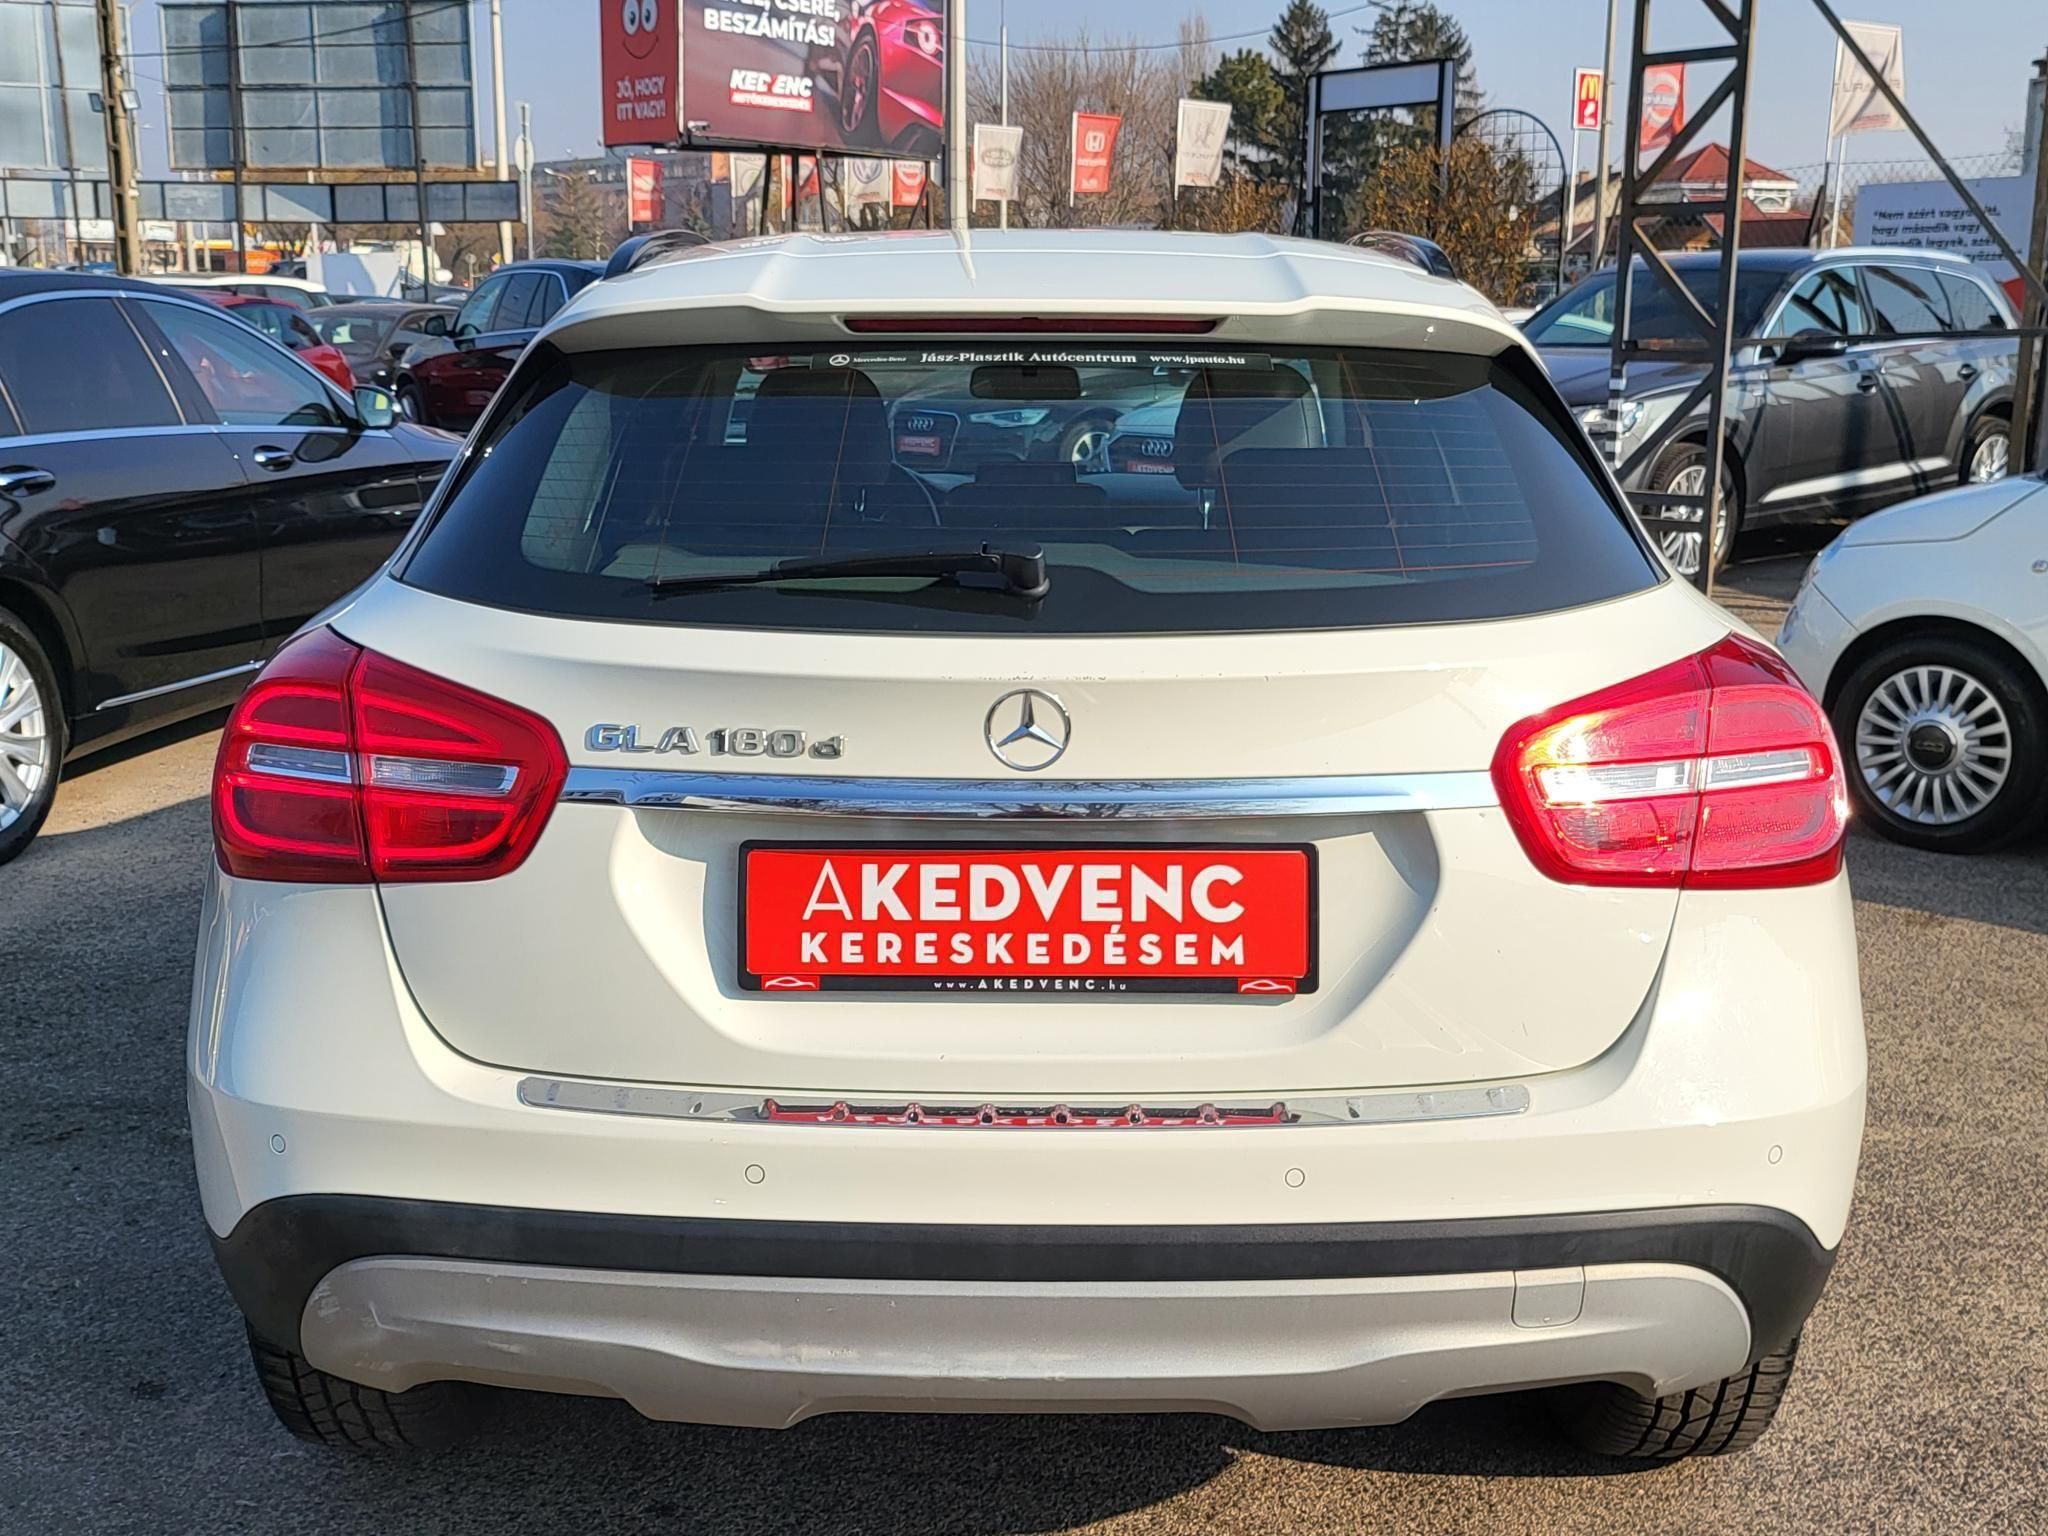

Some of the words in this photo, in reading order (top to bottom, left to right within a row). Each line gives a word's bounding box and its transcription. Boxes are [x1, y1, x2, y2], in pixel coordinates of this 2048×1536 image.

[703, 8, 835, 47] BESZÁMÍTÁS!
[635, 75, 665, 97] HOGY
[920, 352, 1024, 363] Jász-Plasztik
[1028, 352, 1137, 363] Autócentrum
[1149, 354, 1246, 365] www.jpauto.hu
[585, 723, 701, 753] GLA
[800, 924, 1246, 966] KERESKEDÉSEM
[933, 978, 1127, 991] www.AKEDVENC.hu
